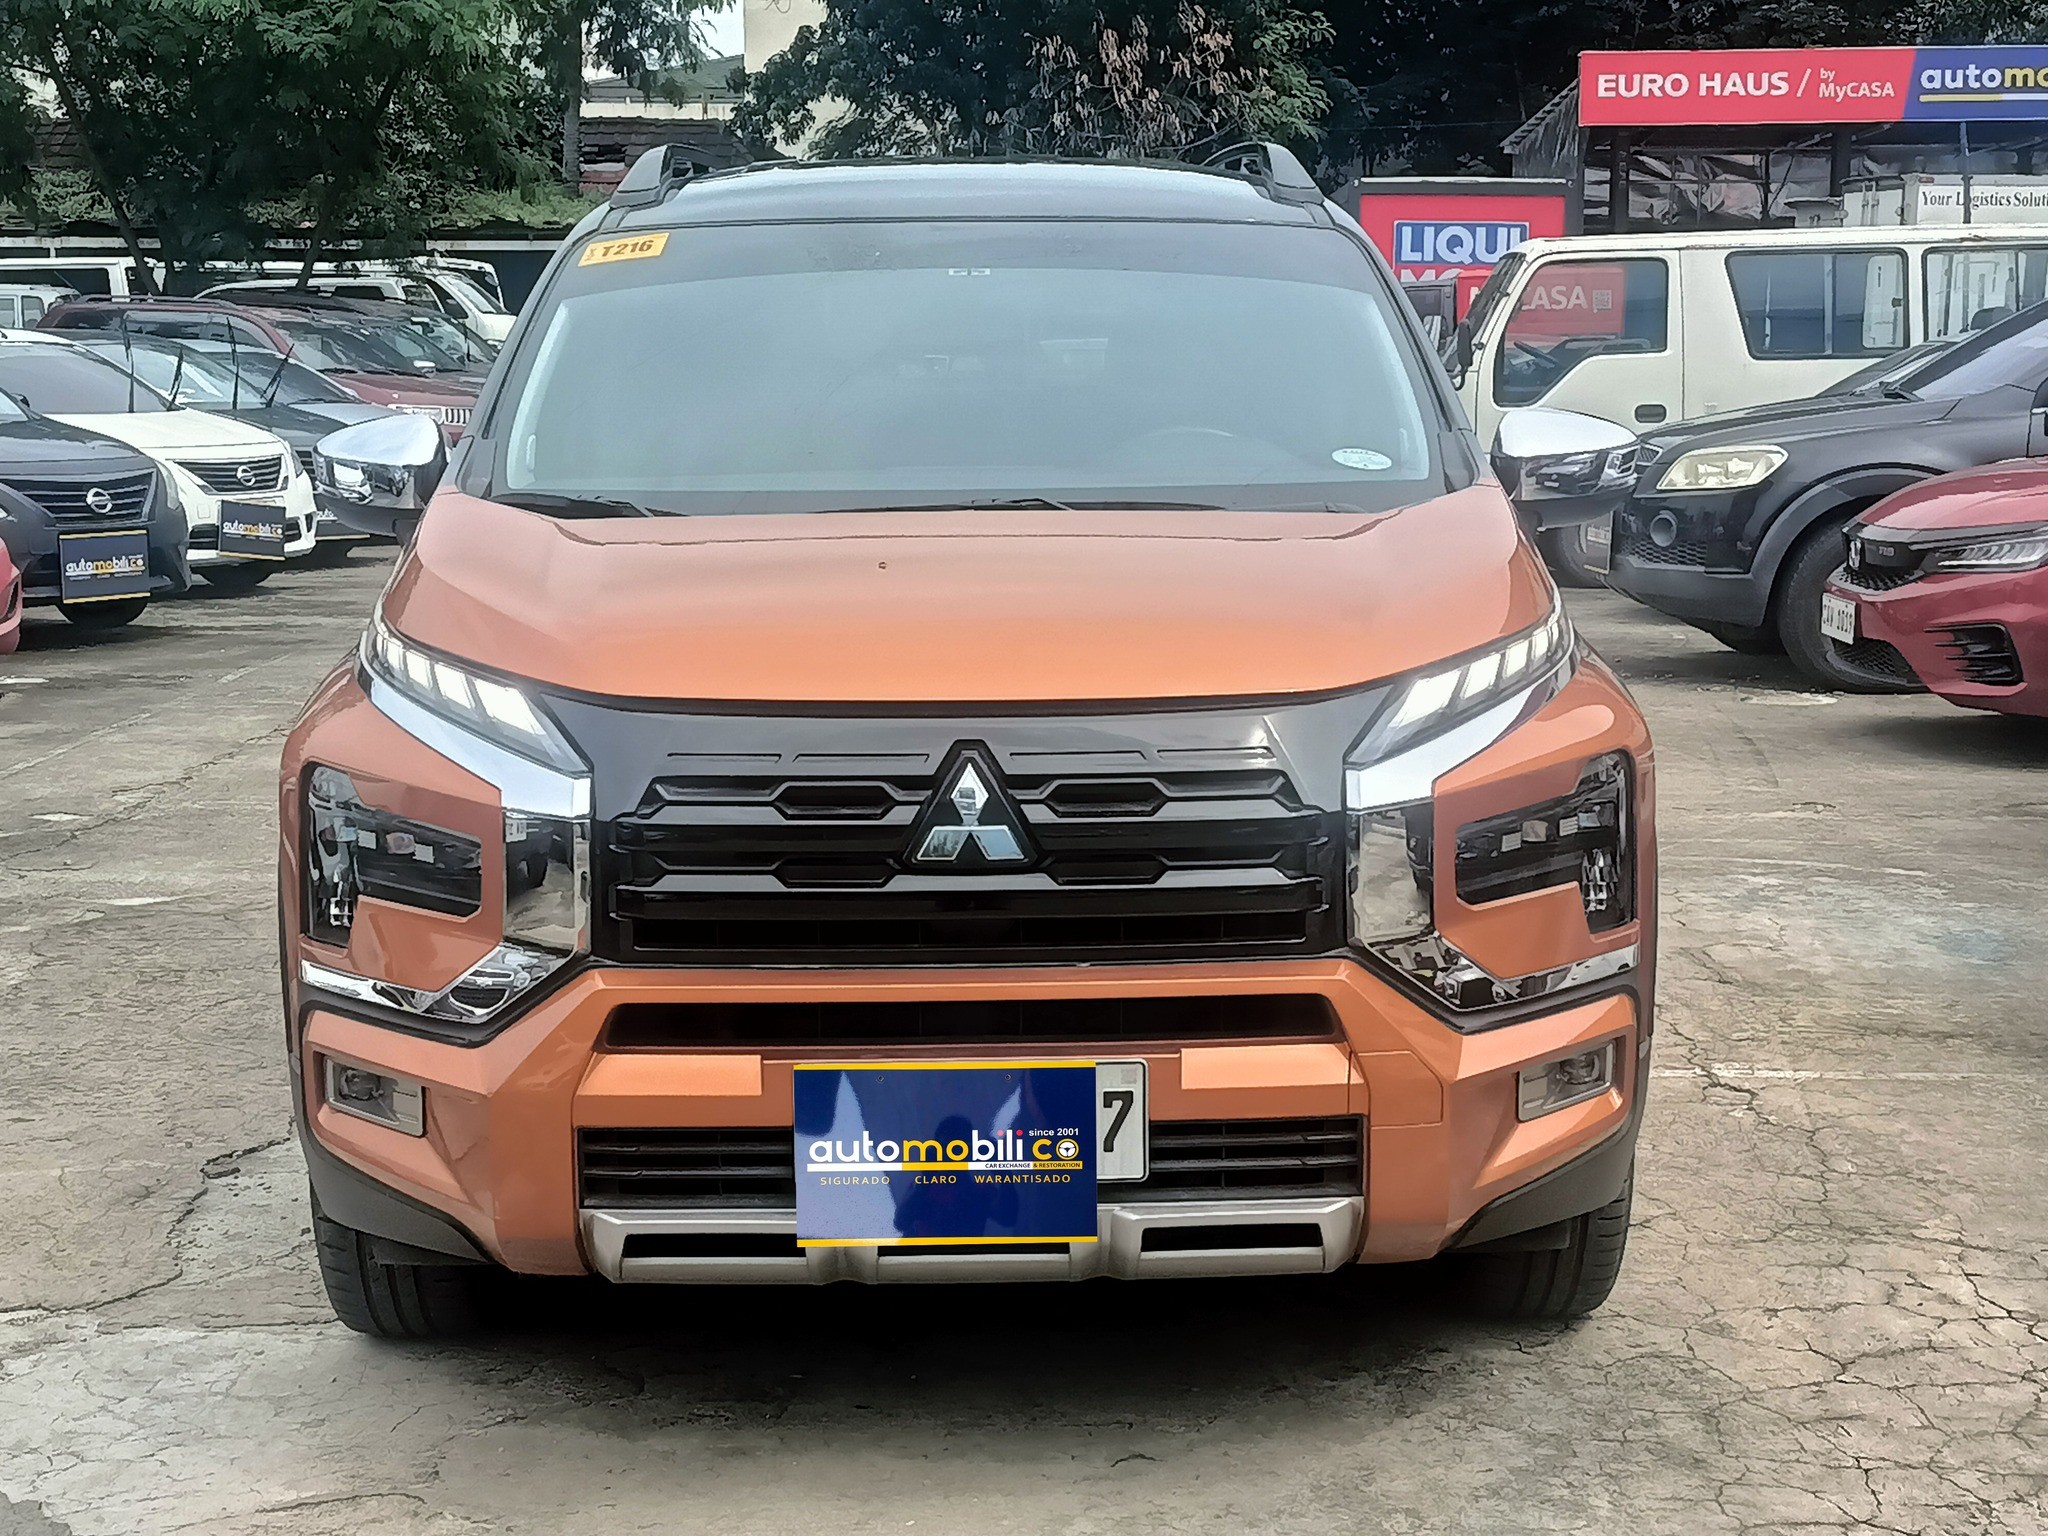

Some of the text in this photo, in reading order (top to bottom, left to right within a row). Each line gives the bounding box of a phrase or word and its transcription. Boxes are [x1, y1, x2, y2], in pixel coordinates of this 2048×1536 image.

[1819, 67, 1836, 81] by
[1597, 73, 1690, 98] EURO
[1699, 71, 1790, 97] HAUS
[1818, 82, 1896, 102] MyCASA
[1922, 191, 1953, 207] Your
[1956, 191, 2012, 210] Lgistics
[601, 240, 655, 257] T216
[1102, 1090, 1134, 1153] 7
[1028, 1127, 1079, 1137] since 2001
[820, 1174, 1071, 1186] SIGURADO CLARO WARANTISADO
